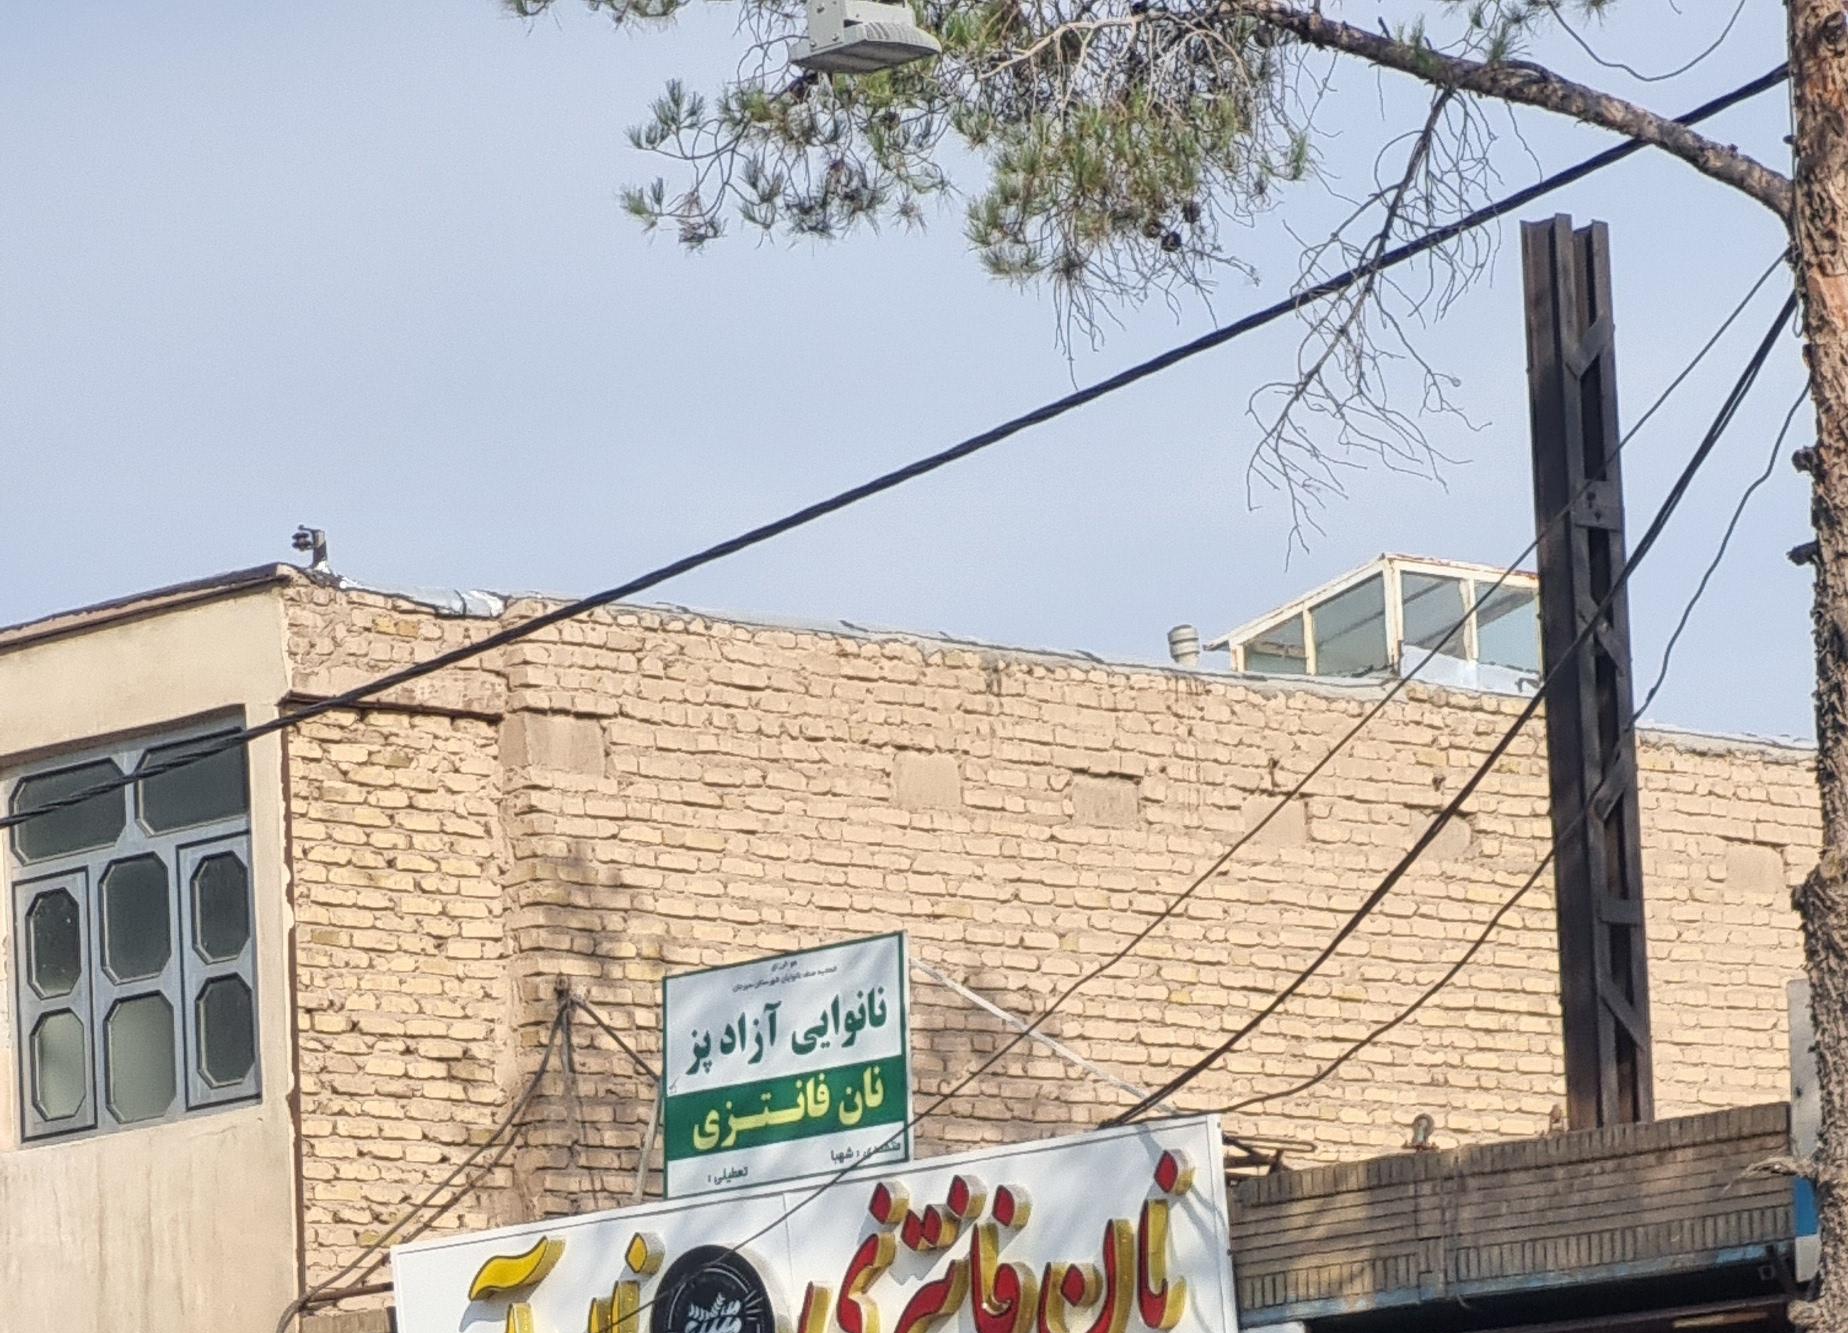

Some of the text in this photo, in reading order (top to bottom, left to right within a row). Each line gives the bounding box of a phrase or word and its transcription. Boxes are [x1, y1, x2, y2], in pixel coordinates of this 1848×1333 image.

[790, 986, 888, 1056] نانوایی
[692, 1065, 884, 1150] نان فانتزی
